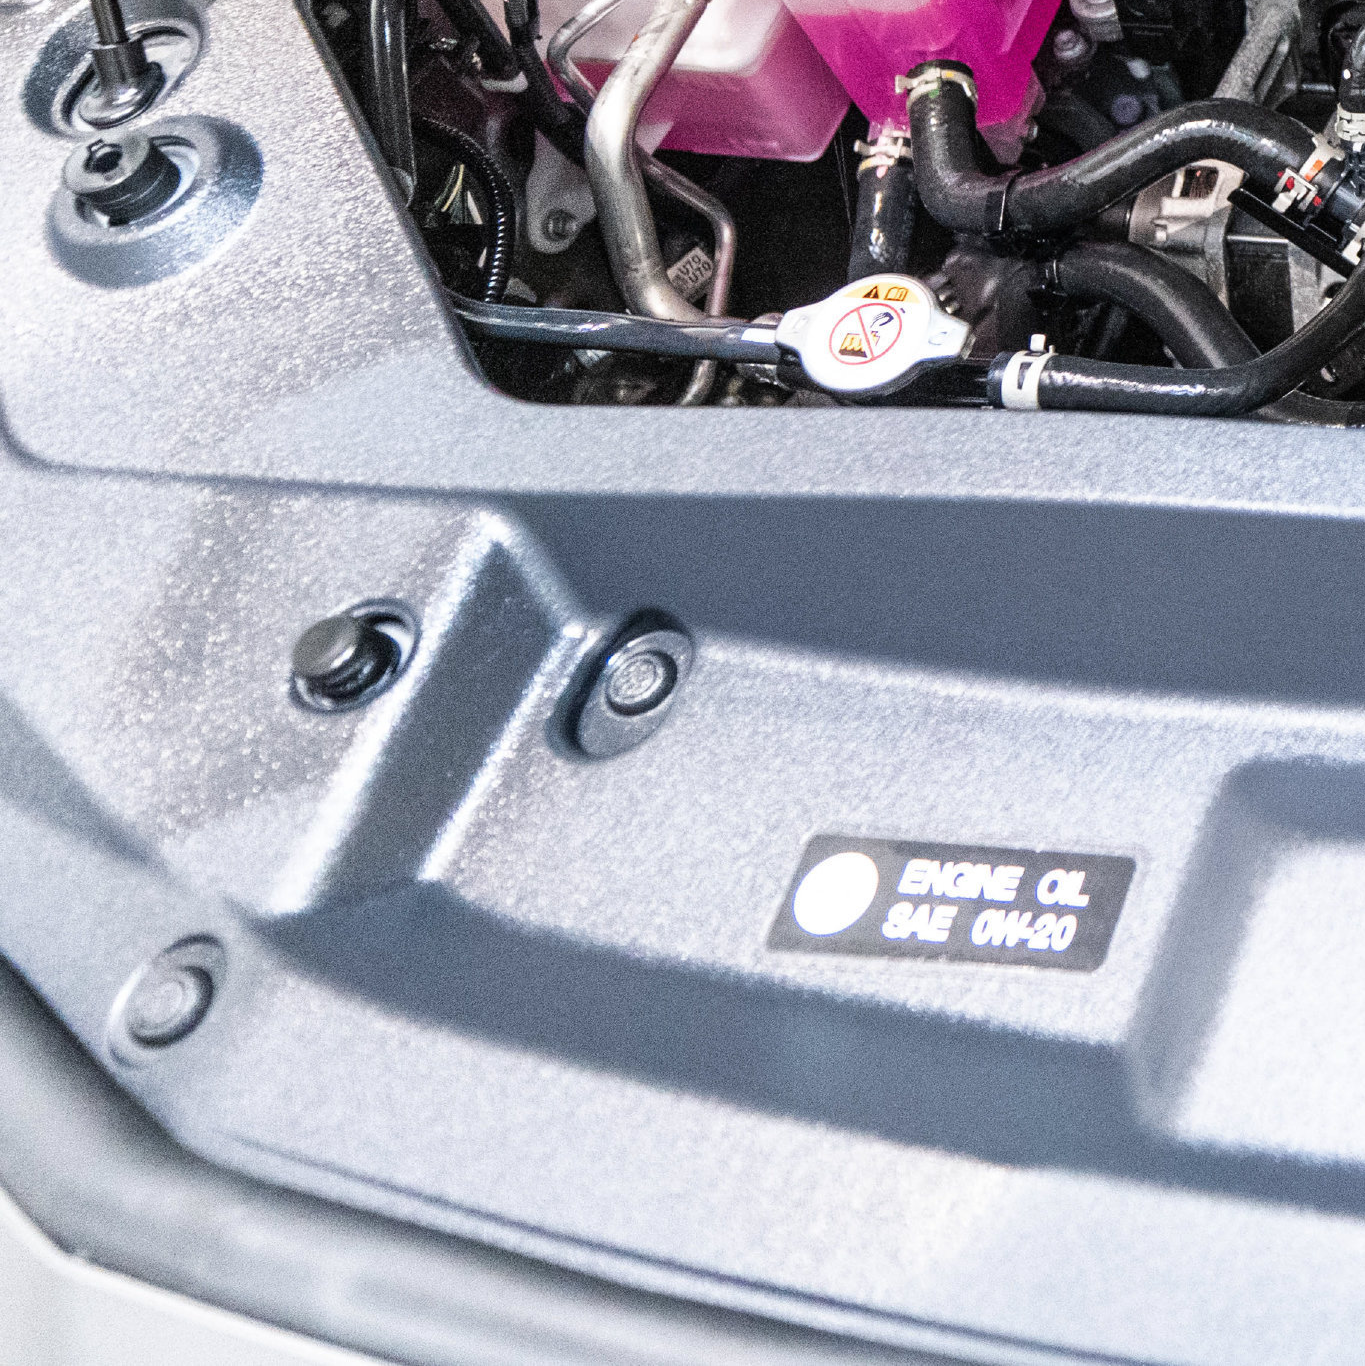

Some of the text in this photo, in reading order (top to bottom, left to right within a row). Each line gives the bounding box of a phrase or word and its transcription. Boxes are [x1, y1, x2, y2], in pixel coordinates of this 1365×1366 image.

[678, 254, 701, 276] U70
[688, 261, 712, 284] U70
[897, 858, 1090, 909] ENGINE OIL
[881, 901, 1078, 953] SAE 0W-20
